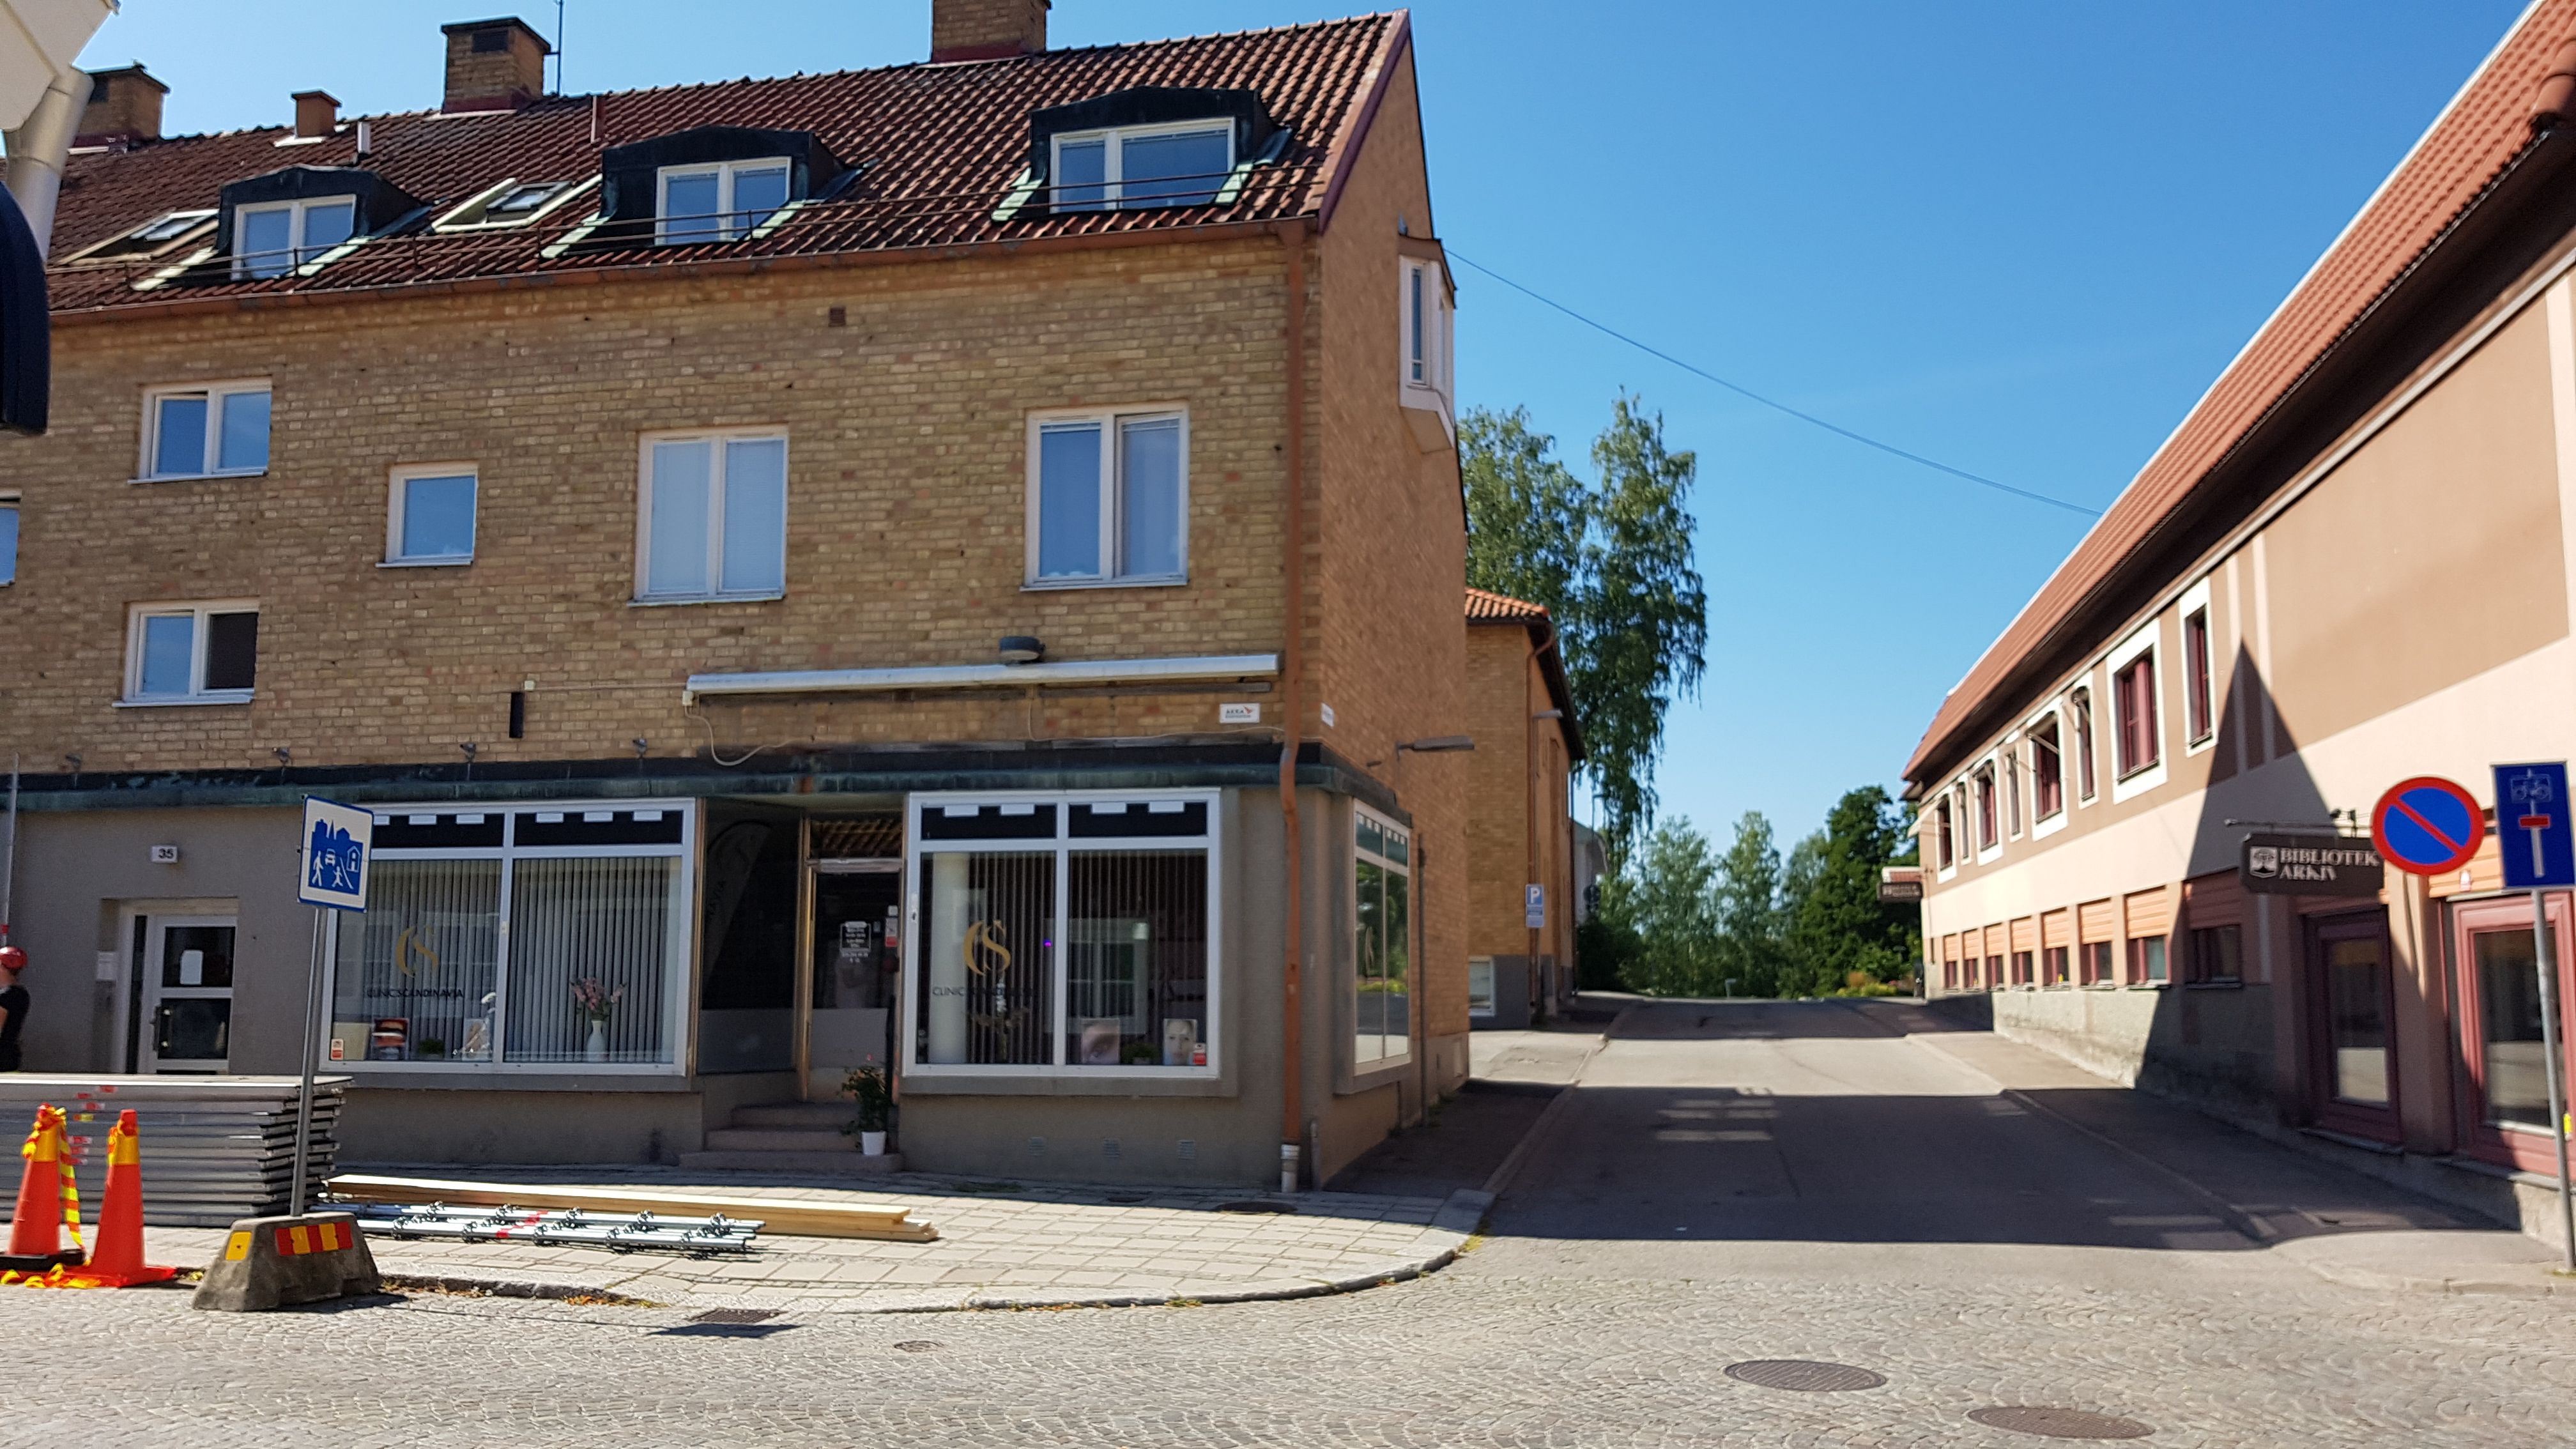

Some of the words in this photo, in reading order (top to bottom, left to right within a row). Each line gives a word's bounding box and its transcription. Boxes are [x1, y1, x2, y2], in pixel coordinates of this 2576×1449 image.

[158, 848, 174, 859] 35
[2280, 847, 2380, 867] BIBLIOTEK
[2279, 864, 2337, 881] ARKIV
[1530, 887, 1541, 904] P
